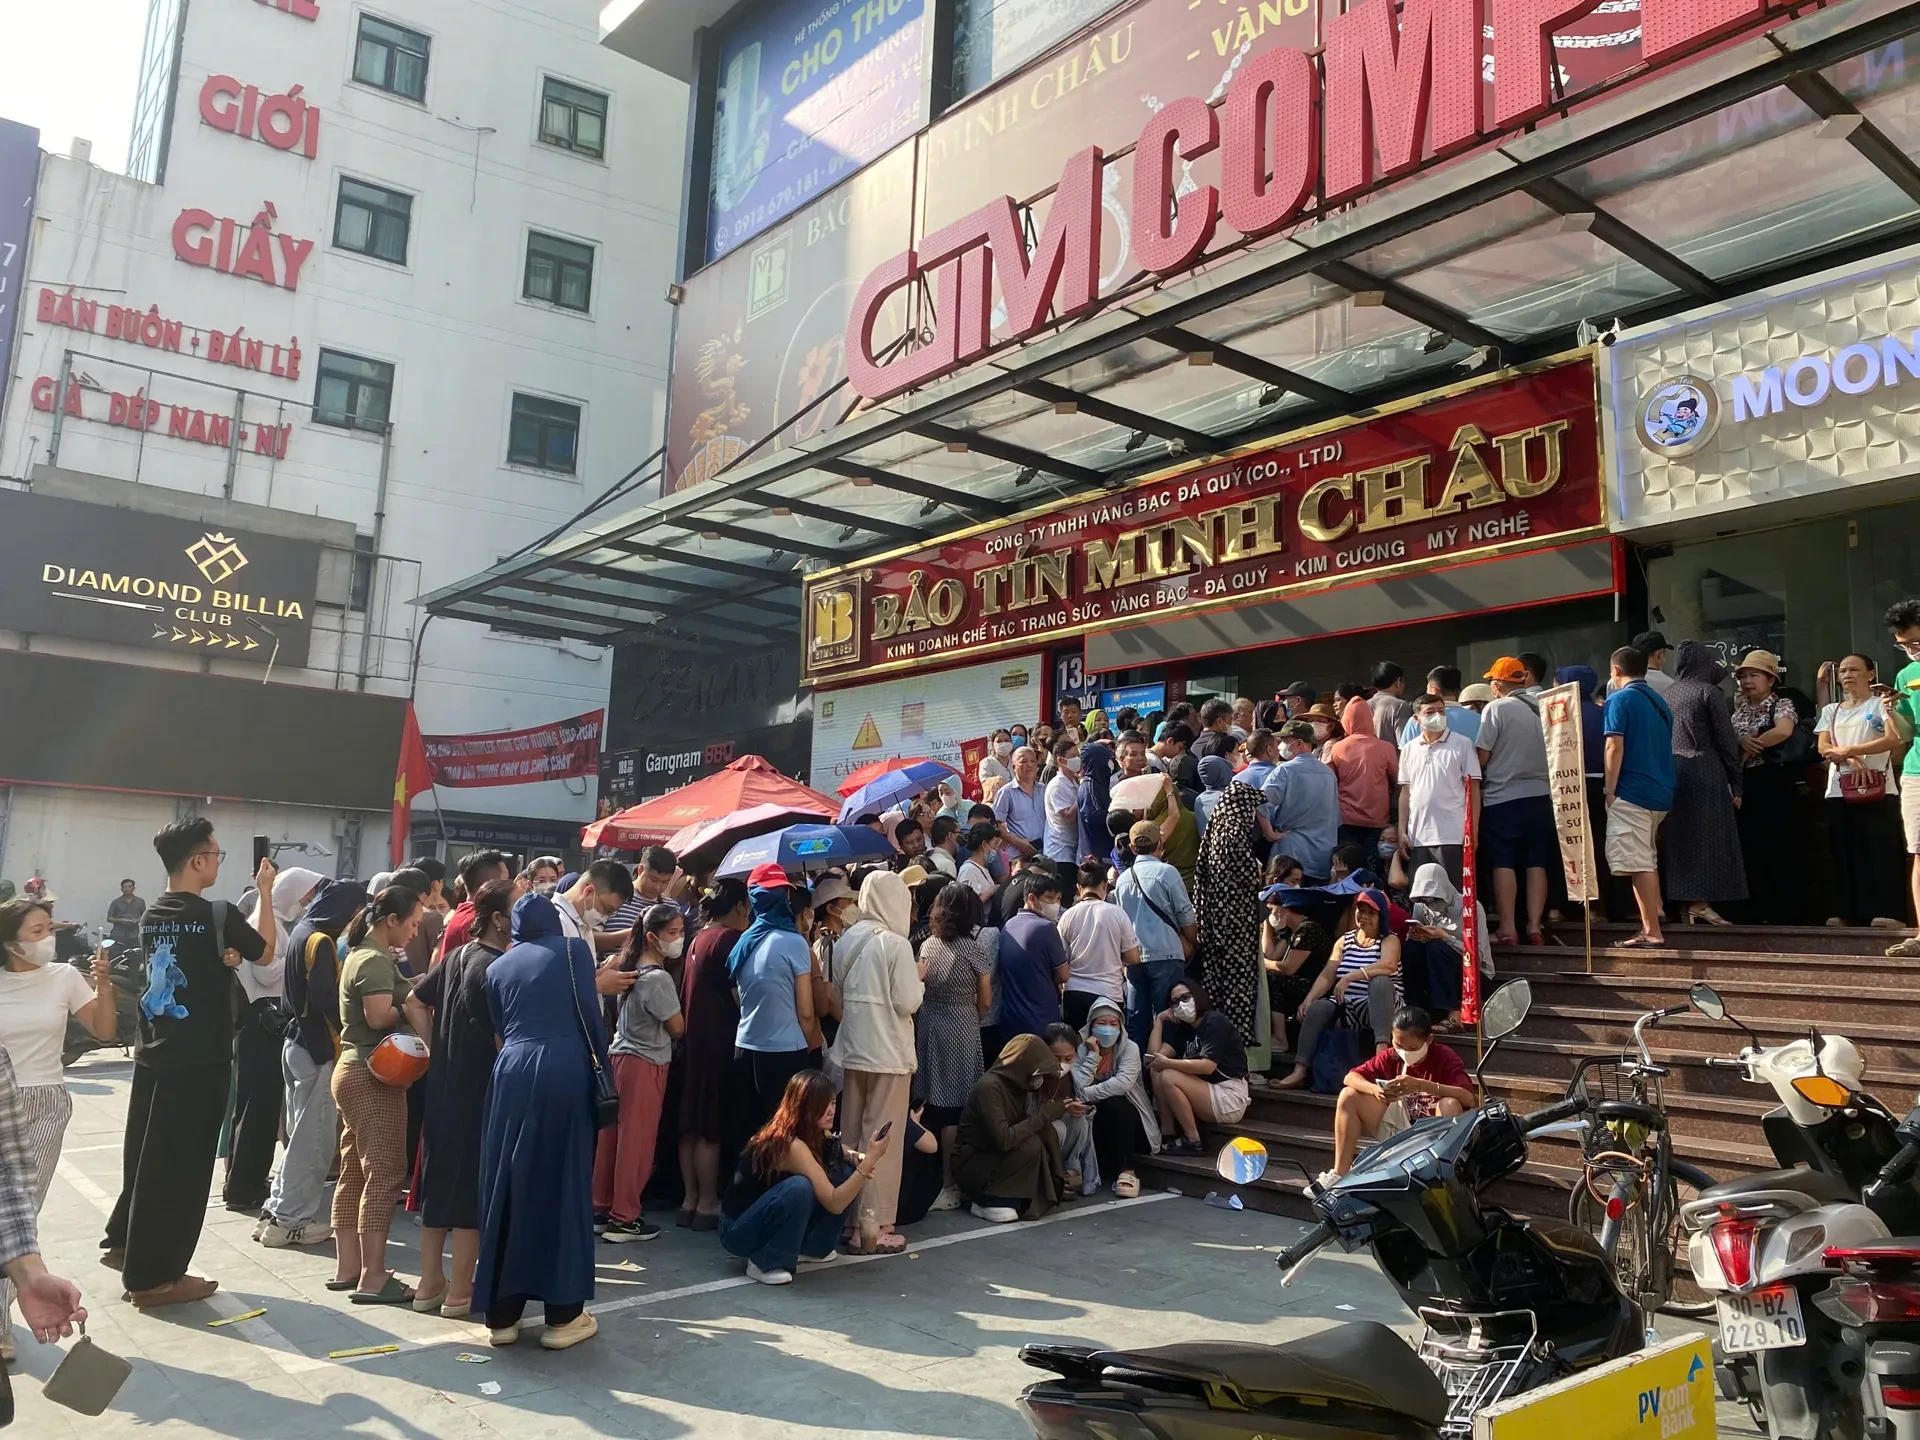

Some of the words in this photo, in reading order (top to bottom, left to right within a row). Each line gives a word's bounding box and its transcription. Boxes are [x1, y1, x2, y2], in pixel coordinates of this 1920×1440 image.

[781, 28, 843, 96] CHO
[1030, 22, 1136, 110] CHÂU
[199, 75, 321, 160] GIỚI
[172, 200, 315, 292] GIẦY
[37, 284, 98, 334] BÁN
[105, 304, 183, 354] BUÔN
[207, 326, 263, 372] BÁN
[271, 335, 302, 380] LẺ
[1732, 329, 1920, 423] MOON
[168, 404, 230, 448] NAM
[870, 570, 968, 641] BẢO
[973, 543, 1073, 618] TÍN
[1082, 492, 1283, 594] MINH
[1297, 418, 1570, 543] CHÂU
[985, 531, 1023, 555] CÔNG
[1029, 526, 1045, 543] TY
[1049, 514, 1088, 538] TNHH
[1092, 501, 1134, 525] VÀNG
[1137, 491, 1171, 513] BẠC
[1177, 478, 1200, 501] ĐÁ
[1298, 440, 1343, 470] LTD)
[42, 564, 202, 604] DIAMOND
[212, 589, 304, 620] BILLIA
[175, 607, 232, 627] CLUB
[887, 641, 915, 659] KINH
[918, 632, 960, 653] DOANH
[962, 621, 988, 645] CHẾ
[991, 617, 1016, 638] TÁC
[1020, 611, 1067, 632] TRANG
[1072, 602, 1102, 621] SỨC
[1110, 592, 1151, 614] VÀNG
[1156, 585, 1189, 607] BẠC
[1204, 576, 1227, 595] ĐÁ
[1231, 565, 1269, 590] QUÝ
[1294, 555, 1328, 578] KIM
[1335, 540, 1405, 569] CƯƠNG
[1427, 524, 1460, 550] MỸ
[1468, 510, 1530, 542] NGHỆ
[645, 750, 702, 775] Gangnam
[704, 741, 735, 765] BBQ
[159, 921, 171, 933] de
[171, 920, 180, 933] la
[184, 920, 205, 934] vie
[1727, 1317, 1800, 1350] 229.10
